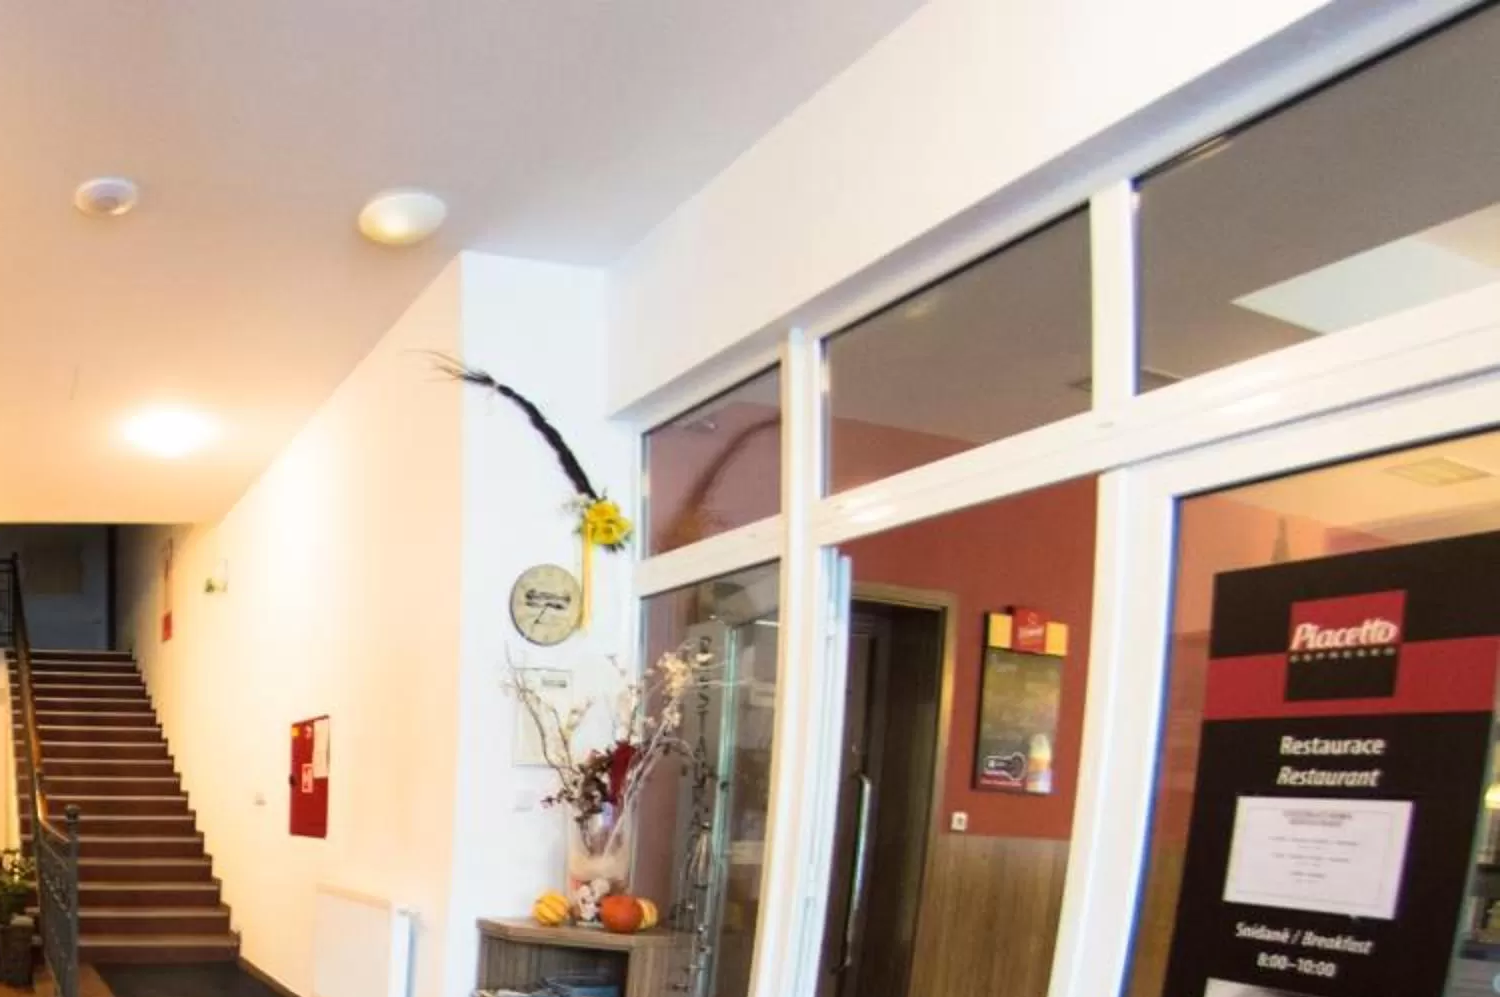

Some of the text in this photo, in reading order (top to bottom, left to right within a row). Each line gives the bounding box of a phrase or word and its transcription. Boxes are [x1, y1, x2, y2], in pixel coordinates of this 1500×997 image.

[1290, 617, 1398, 651] Piacetto
[1280, 735, 1386, 755] Restaurace
[1276, 765, 1381, 787] Restaurant
[1301, 931, 1374, 955] Breakfast
